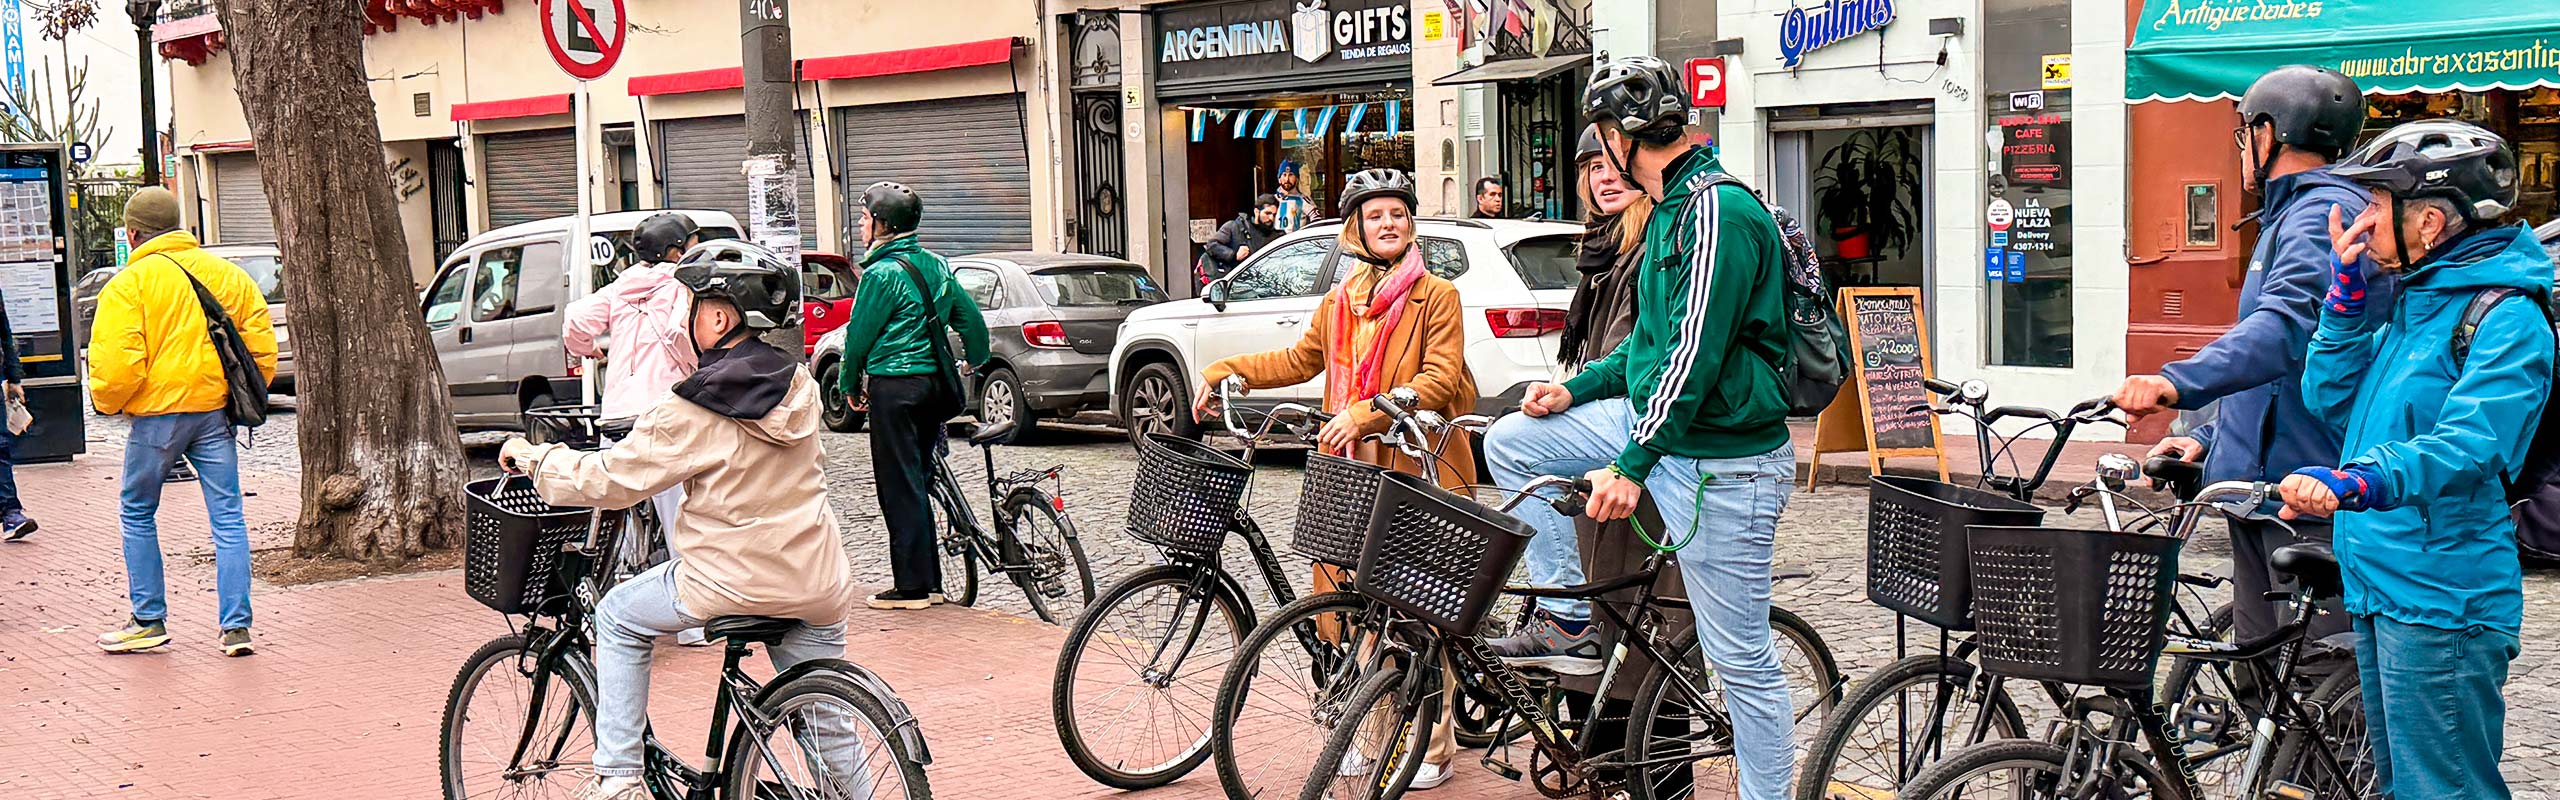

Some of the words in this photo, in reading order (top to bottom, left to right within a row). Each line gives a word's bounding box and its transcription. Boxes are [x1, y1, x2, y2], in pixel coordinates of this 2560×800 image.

[1334, 5, 1406, 46] GIFTS
[1780, 0, 1896, 69] Quilmes
[1340, 47, 1366, 60] TIENDA
[1366, 46, 1377, 58] DE
[1377, 43, 1411, 57] REGALOS
[2015, 129, 2043, 138] CAFE
[74, 145, 87, 158] E
[2003, 144, 2056, 155] PIZZERIA
[2026, 198, 2039, 207] LA
[2015, 208, 2051, 218] NUEVA
[2016, 218, 2051, 228] PLAZA
[2017, 231, 2049, 240] Delivery
[575, 581, 596, 608] 86
[1470, 633, 1546, 724] FUTURA
